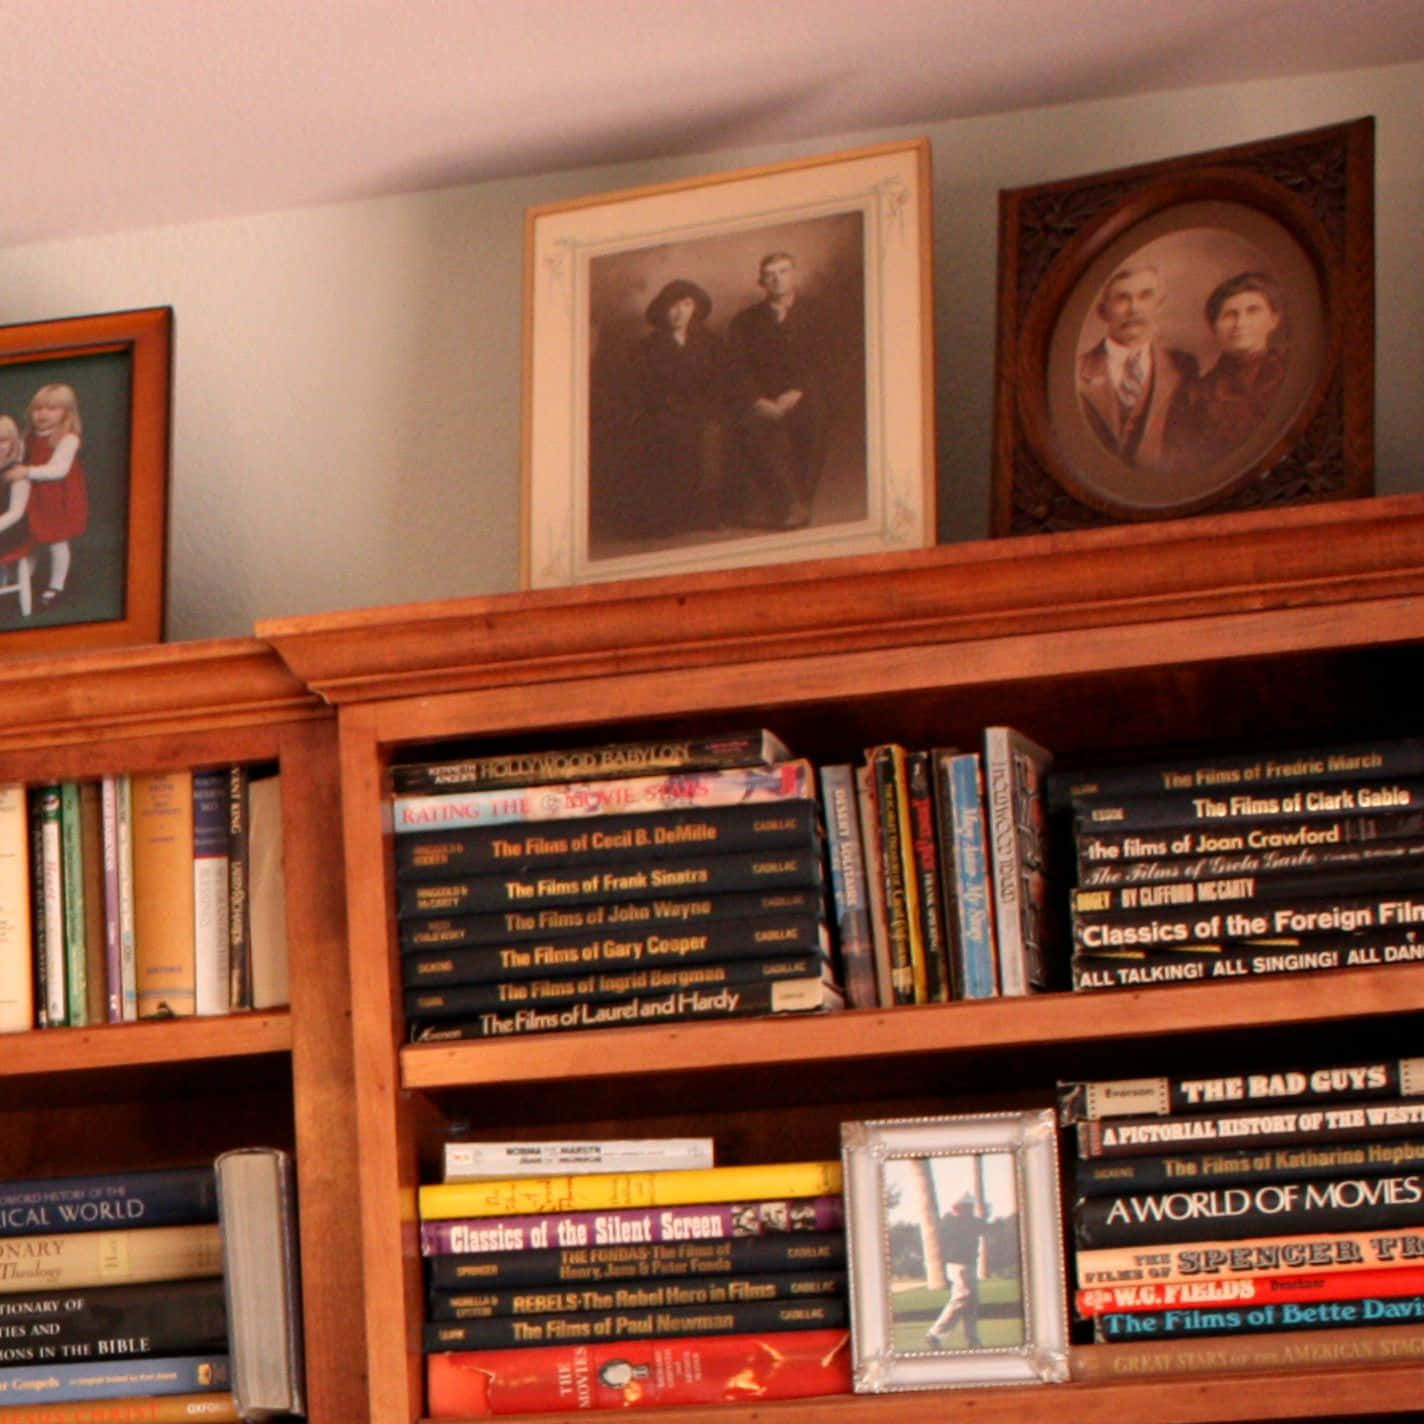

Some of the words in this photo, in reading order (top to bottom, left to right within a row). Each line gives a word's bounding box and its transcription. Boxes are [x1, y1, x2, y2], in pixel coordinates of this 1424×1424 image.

[481, 749, 596, 778] HOLLYWOOD
[602, 744, 690, 770] BABYLON
[402, 796, 480, 825] RATING
[491, 797, 530, 817] THE
[1194, 800, 1227, 818] The
[1231, 796, 1279, 815] Films
[1283, 796, 1302, 811] of
[1306, 792, 1354, 811] Clark
[1358, 788, 1409, 807] Gable
[493, 839, 521, 858] The
[526, 837, 568, 854] Films
[572, 834, 588, 850] of
[593, 831, 633, 850] Cecil
[636, 830, 651, 846] B.
[655, 824, 717, 844] DeMille
[1088, 842, 1119, 859] the
[1123, 838, 1167, 857] films
[1172, 836, 1192, 853] of
[1196, 833, 1242, 852] Joan
[1248, 826, 1340, 848] Crawford
[1083, 921, 1188, 947] Classics
[1195, 917, 1220, 937] of
[1227, 915, 1266, 935] the
[1275, 909, 1373, 932] Foreign
[1081, 968, 1114, 987] ALL
[1118, 964, 1202, 984] TALKING!
[1213, 960, 1248, 976] ALL
[1253, 953, 1338, 973] SINGING!
[1347, 948, 1381, 965] ALL
[1385, 944, 1424, 962] DAN
[481, 1015, 516, 1035] The
[517, 1010, 559, 1030] Films
[561, 1006, 581, 1026] of
[583, 1000, 639, 1023] Laurel
[641, 996, 675, 1017] and
[678, 987, 739, 1013] Hardy
[1181, 1077, 1243, 1103] THE
[1249, 1074, 1305, 1097] BAD
[1311, 1066, 1387, 1092] GUYS
[1104, 1128, 1117, 1145] A
[1119, 1119, 1216, 1144] PICTORIAL
[1218, 1114, 1297, 1136] HISTORY
[1300, 1112, 1321, 1130] OF
[1326, 1109, 1364, 1127] THE
[1368, 1103, 1424, 1123] WEST
[60, 1199, 144, 1223] WORLD
[1107, 1200, 1129, 1224] A
[1131, 1190, 1251, 1221] WORLD
[1256, 1186, 1298, 1214] OF
[1305, 1177, 1422, 1210] MOVIES
[451, 1225, 523, 1253] Classics
[531, 1221, 548, 1248] of
[558, 1219, 587, 1245] the
[595, 1215, 651, 1242] Silent
[661, 1212, 723, 1239] Screen
[0, 1262, 62, 1282] Theology
[1178, 1240, 1363, 1276] SPENCER
[1164, 1281, 1254, 1302] FIELDS
[1104, 1313, 1157, 1335] The
[1164, 1309, 1241, 1331] Films
[1248, 1303, 1274, 1325] of
[1283, 1303, 1356, 1324] Bette
[1363, 1297, 1424, 1319] Davi
